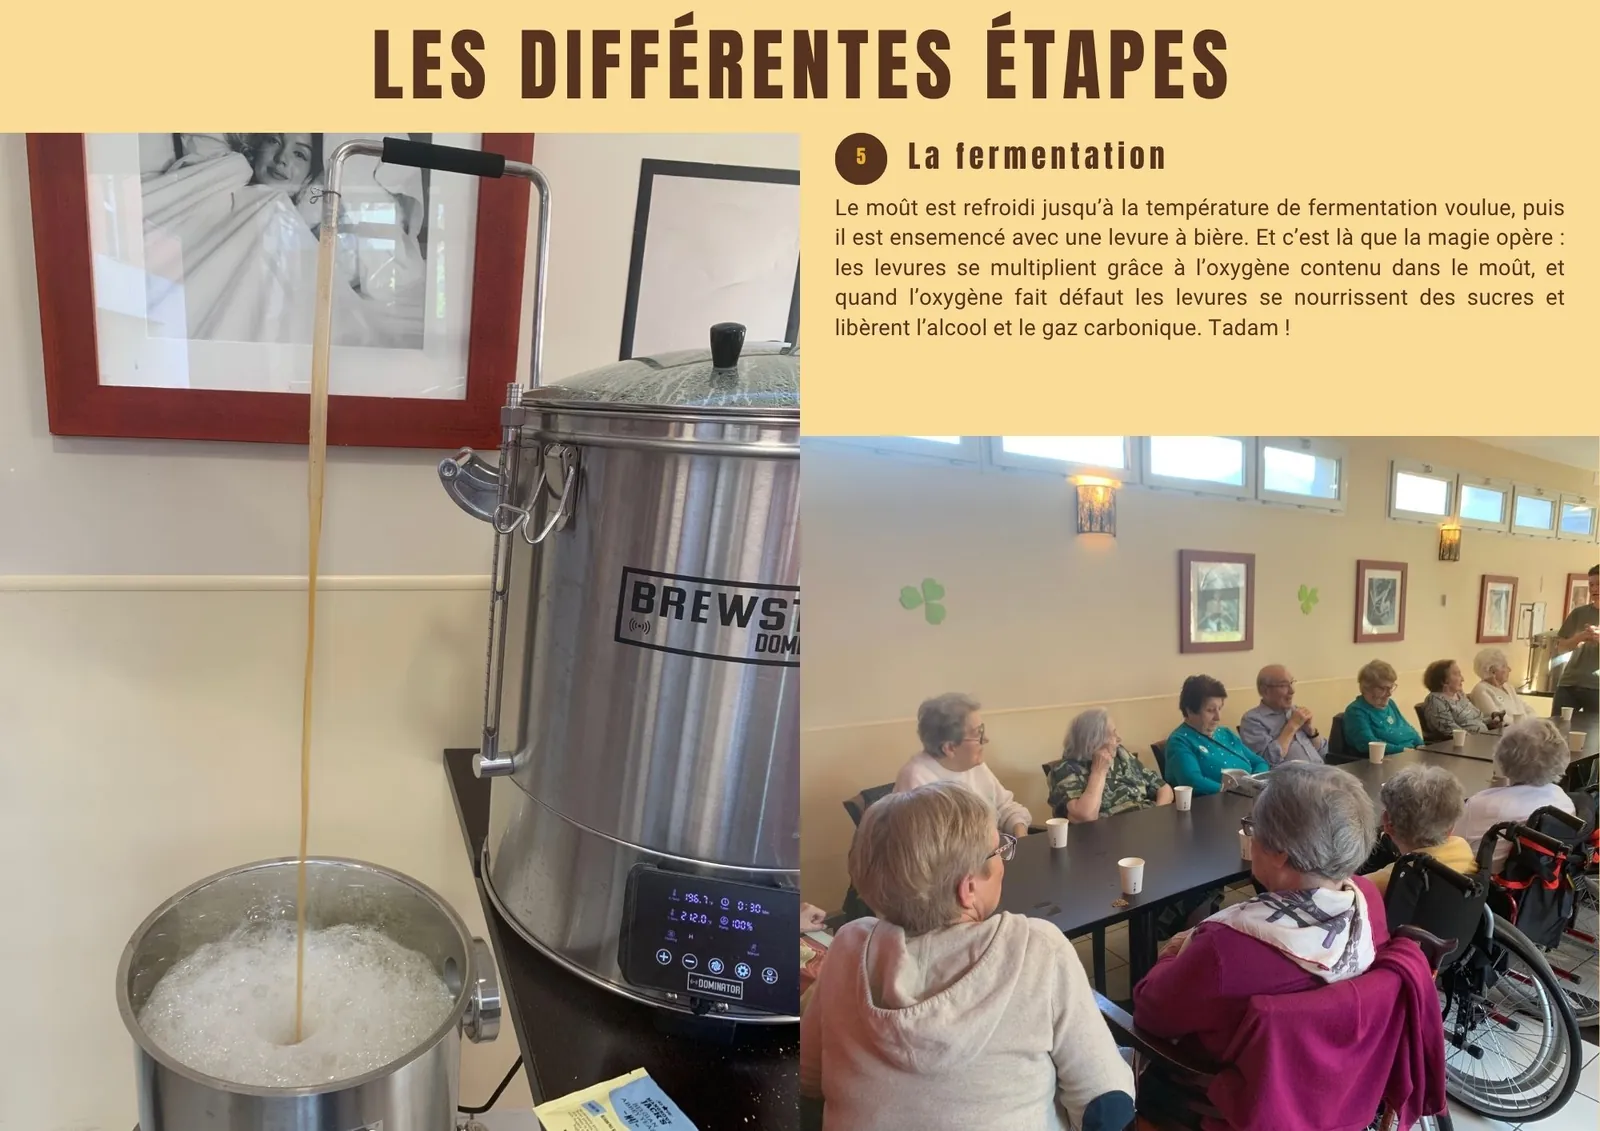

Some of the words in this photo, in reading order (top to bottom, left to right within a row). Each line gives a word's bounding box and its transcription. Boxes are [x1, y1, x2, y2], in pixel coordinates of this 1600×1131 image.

[631, 580, 800, 632] BREWS
[686, 893, 709, 904] 196.7
[737, 900, 761, 914] 0:30
[680, 910, 707, 924] 212.0
[732, 919, 753, 931] 100%
[698, 978, 741, 995] DOMINATOR
